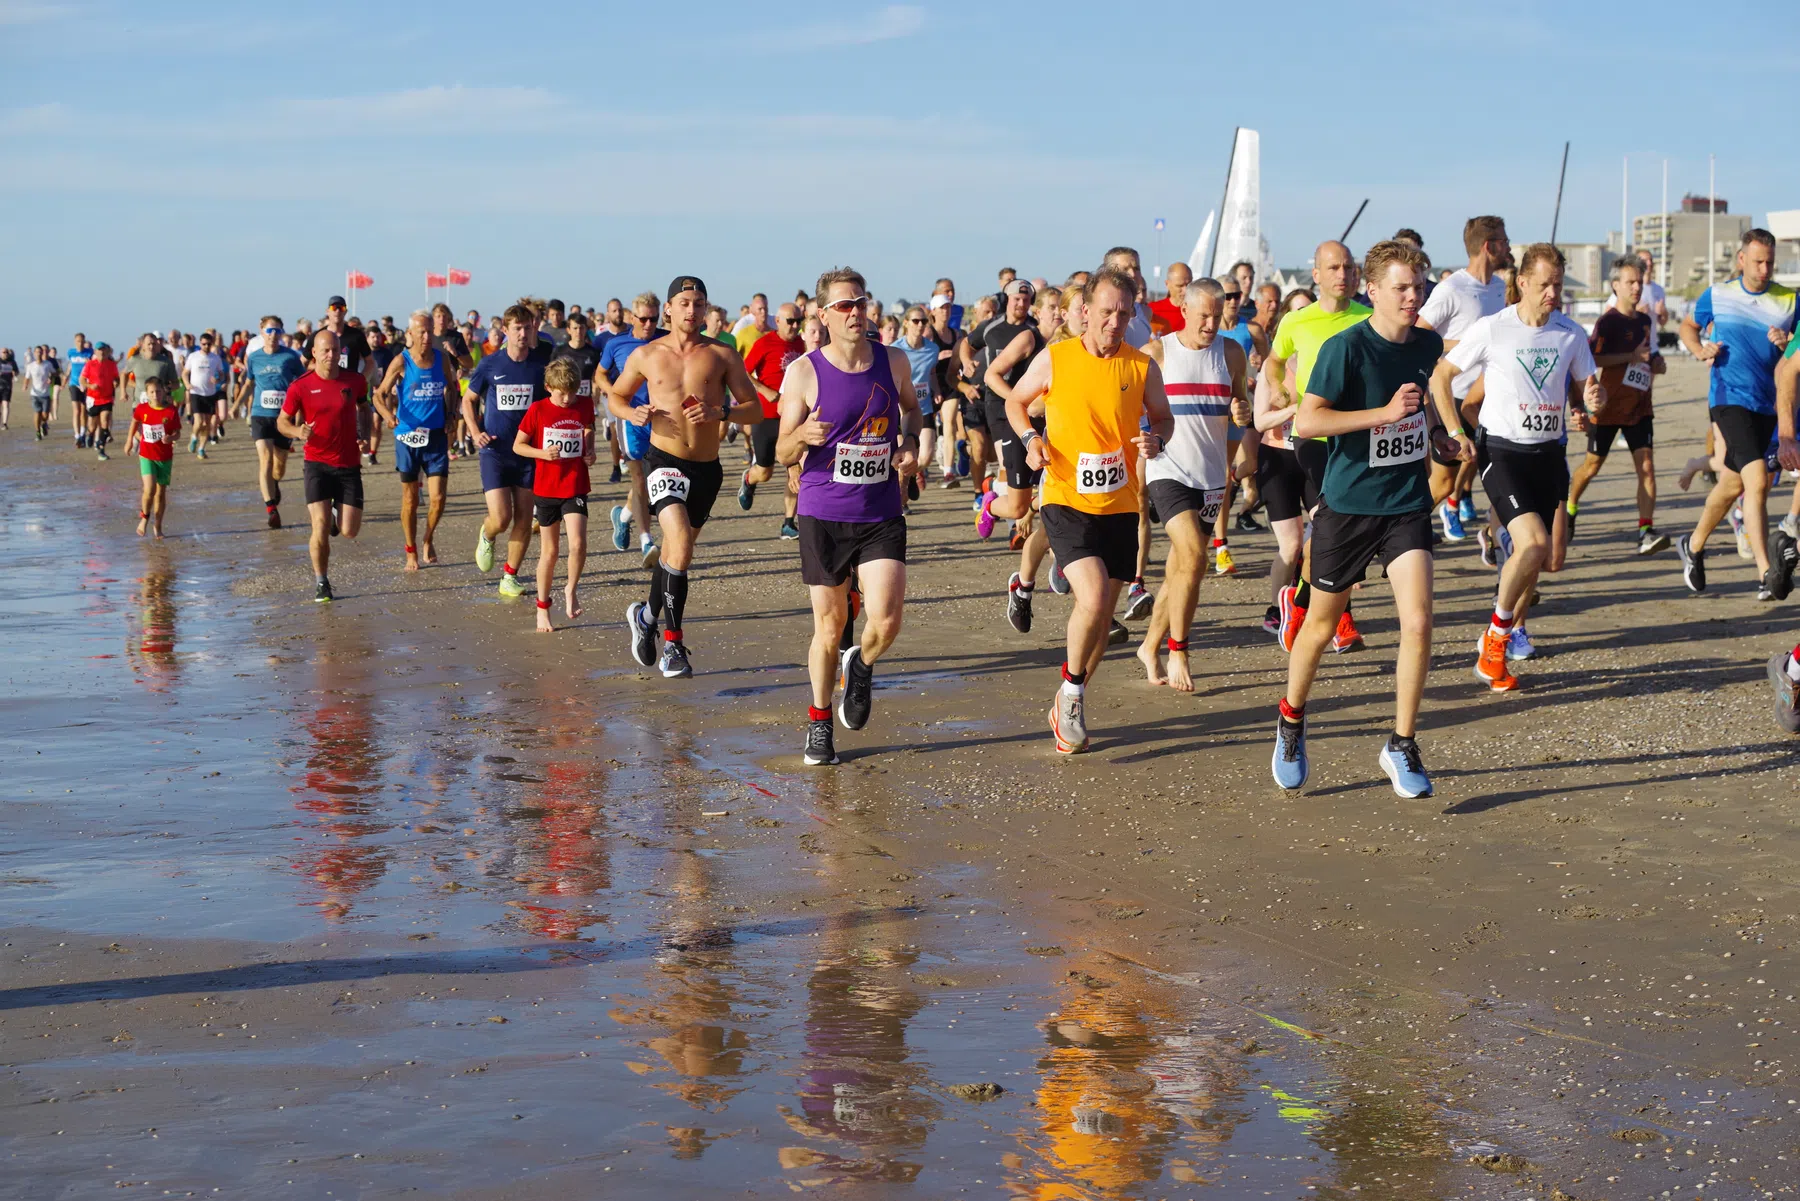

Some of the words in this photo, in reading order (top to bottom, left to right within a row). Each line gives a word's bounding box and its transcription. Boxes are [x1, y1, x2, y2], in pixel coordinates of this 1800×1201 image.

[1527, 347, 1558, 355] SPARTAAN
[414, 389, 444, 397] GROEP
[421, 382, 444, 390] LOOP
[500, 394, 530, 406] 8977
[1522, 415, 1559, 432] 4320
[1376, 430, 1425, 459] 8854
[839, 458, 886, 478] 8864
[1082, 462, 1124, 487] 8926
[651, 478, 687, 498] 8924
